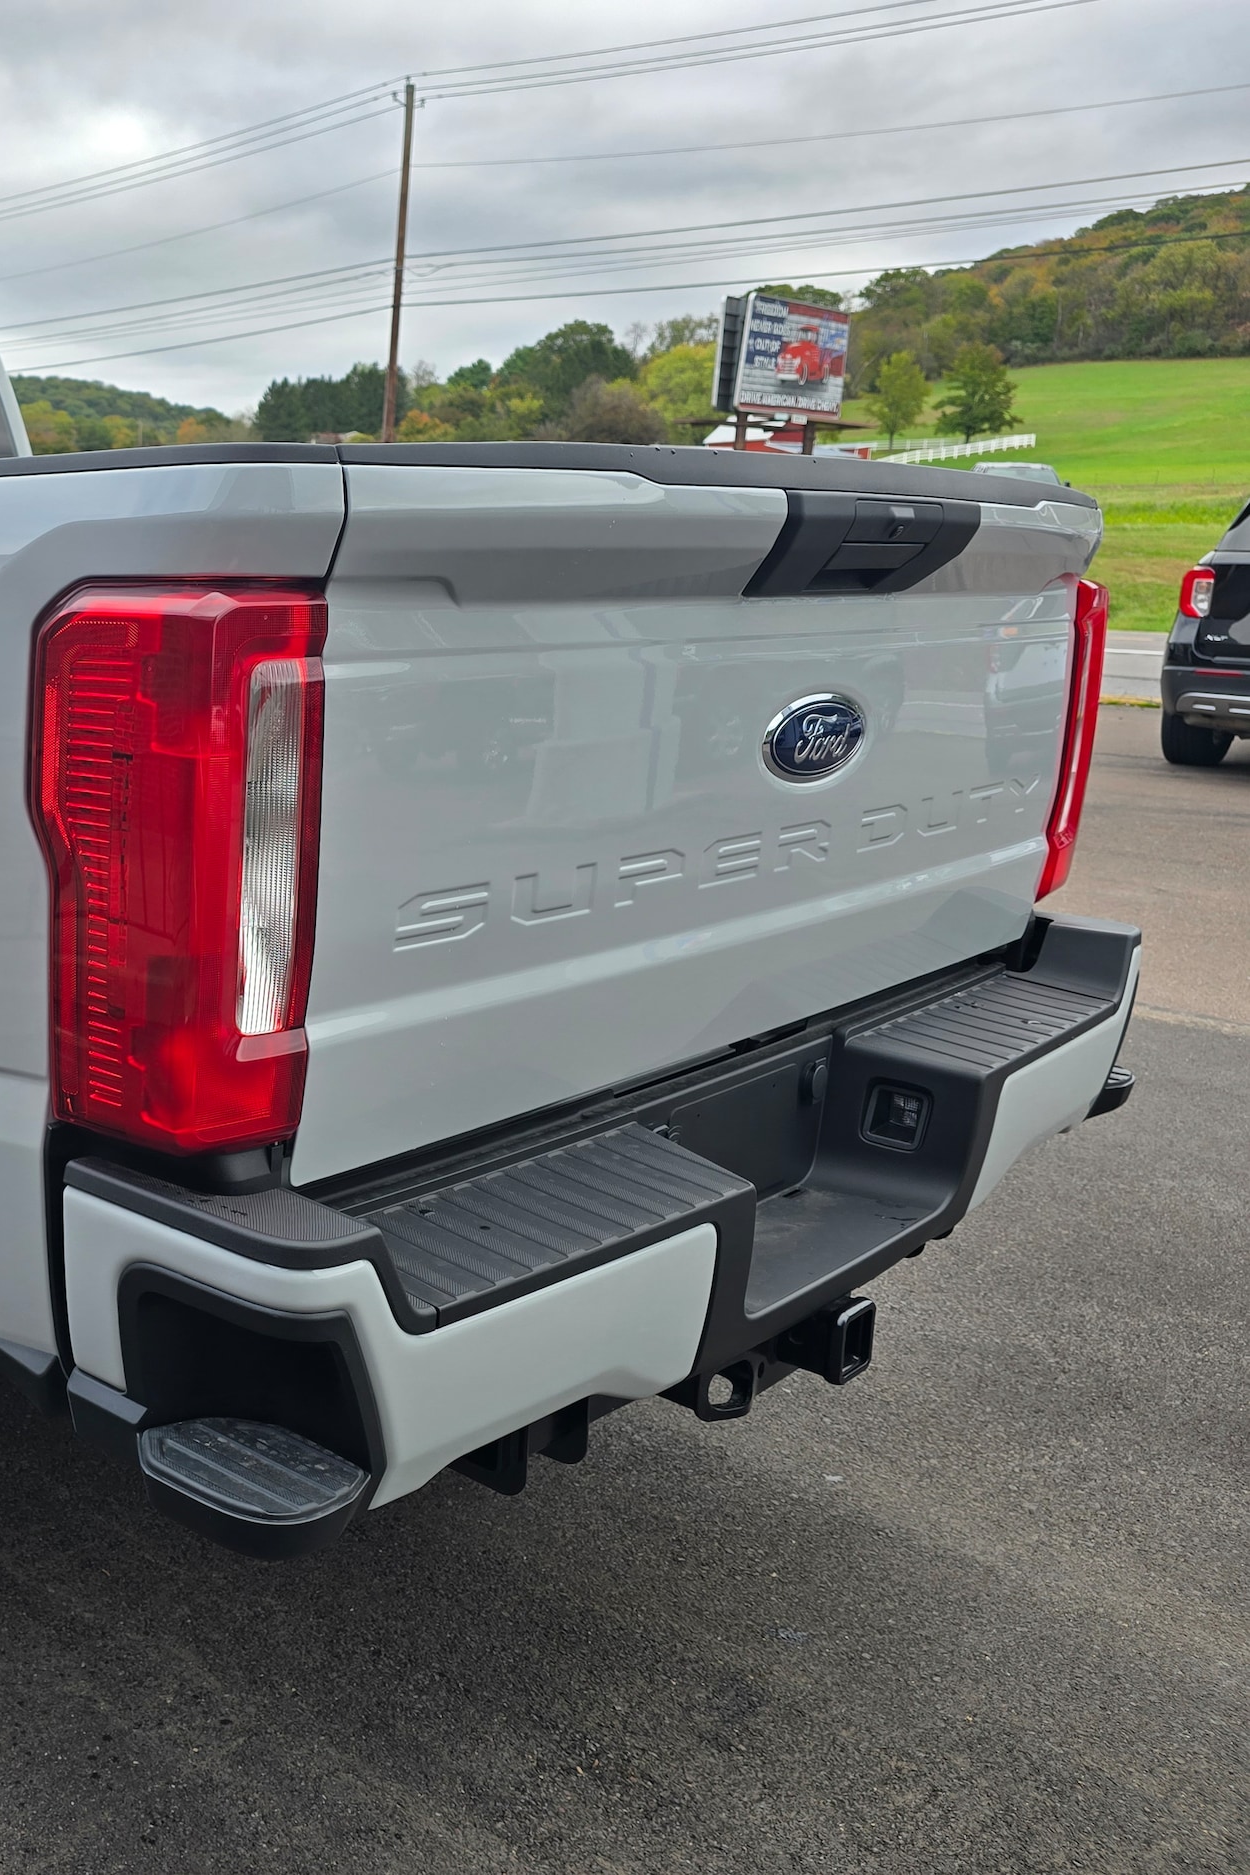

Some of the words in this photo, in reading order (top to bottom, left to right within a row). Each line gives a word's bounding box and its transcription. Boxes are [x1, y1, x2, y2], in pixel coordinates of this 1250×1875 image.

[794, 713, 851, 765] Ford
[392, 819, 832, 953] SUPER
[856, 773, 1041, 854] DUTY
